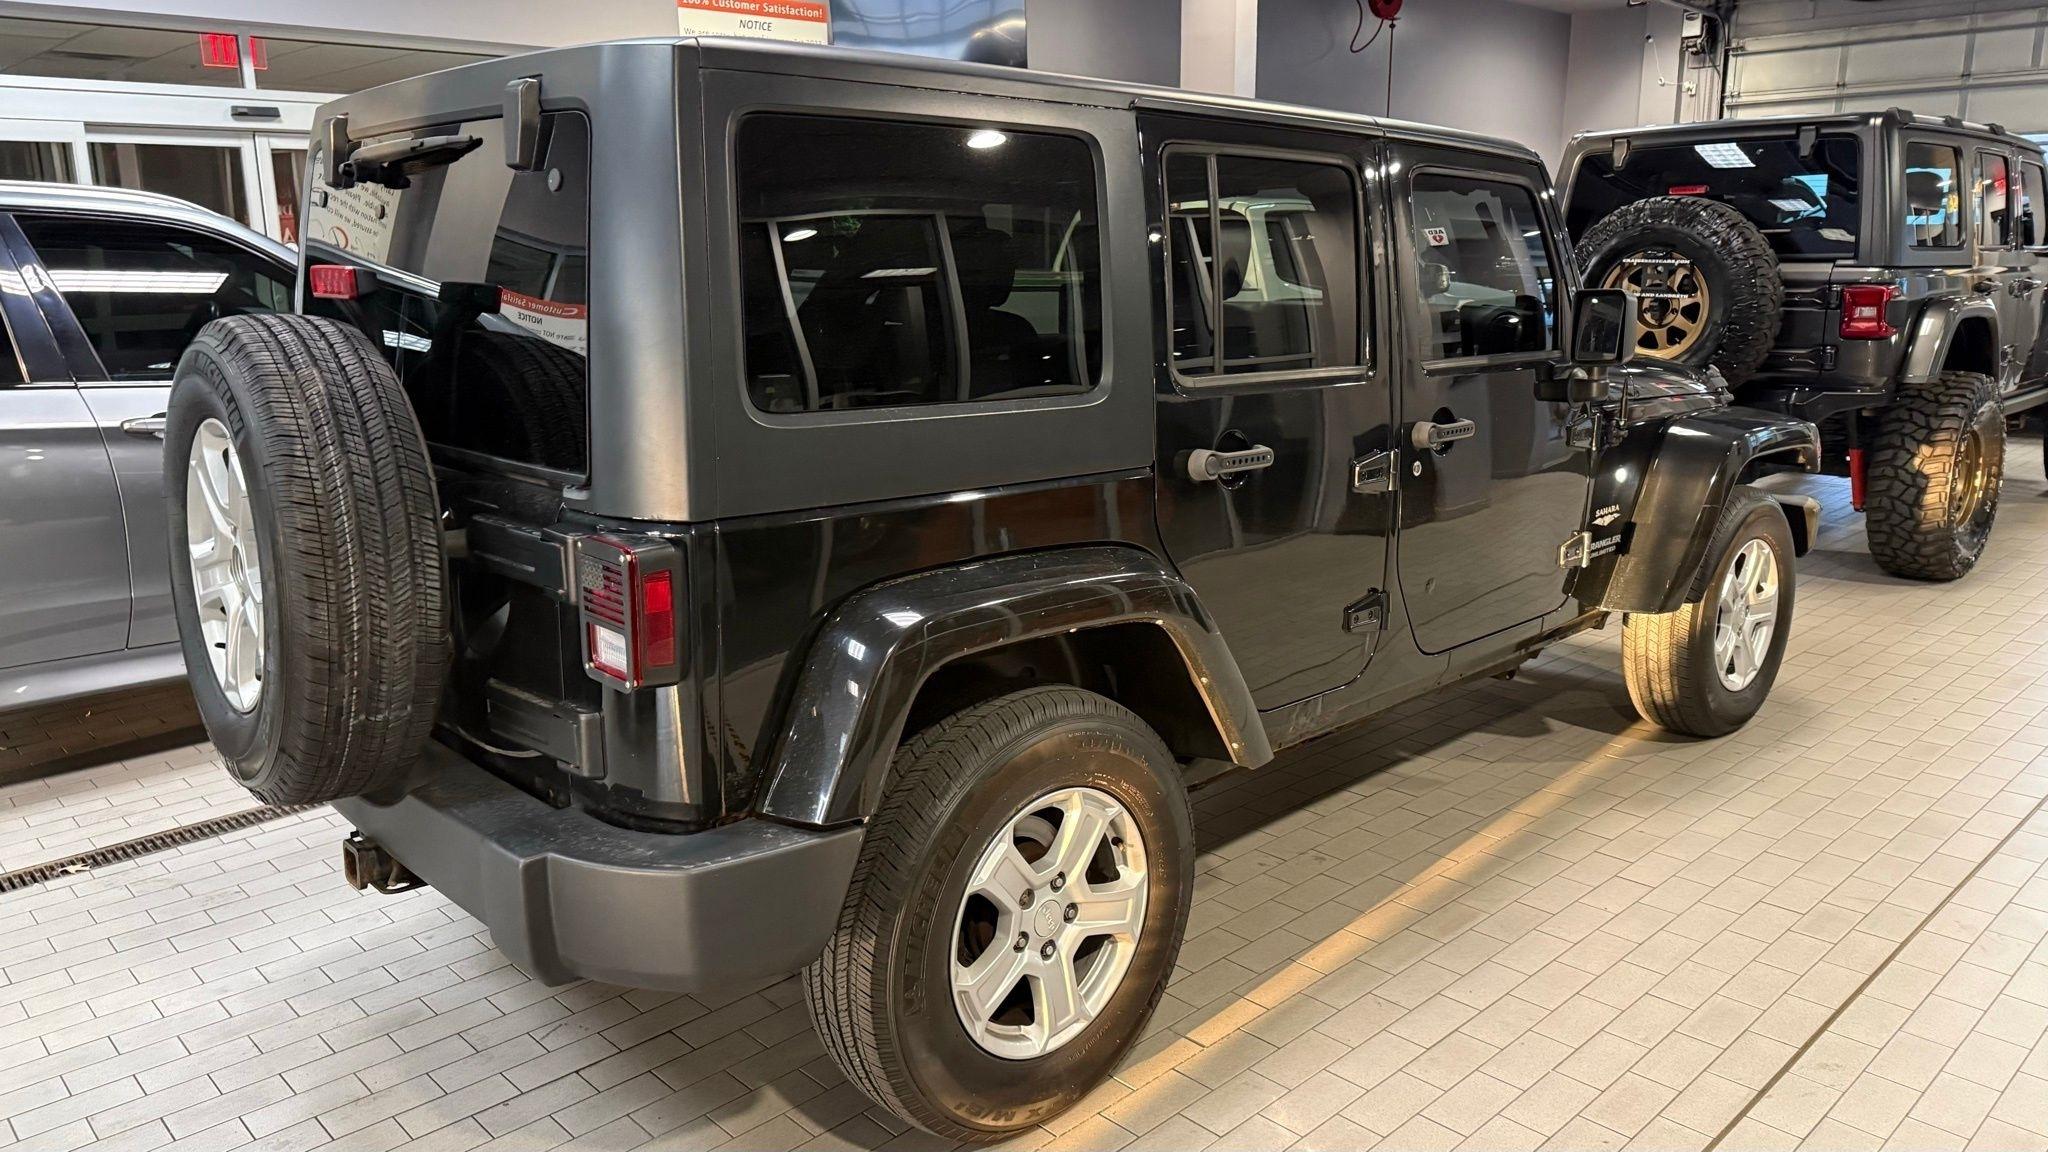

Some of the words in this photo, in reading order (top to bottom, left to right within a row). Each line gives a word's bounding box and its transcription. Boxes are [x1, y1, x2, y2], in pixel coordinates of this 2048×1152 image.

[711, 0, 760, 12] Customer
[762, 2, 824, 18] Satisfaction!
[739, 19, 773, 32] NOTICE
[1595, 503, 1620, 518] SAHARA
